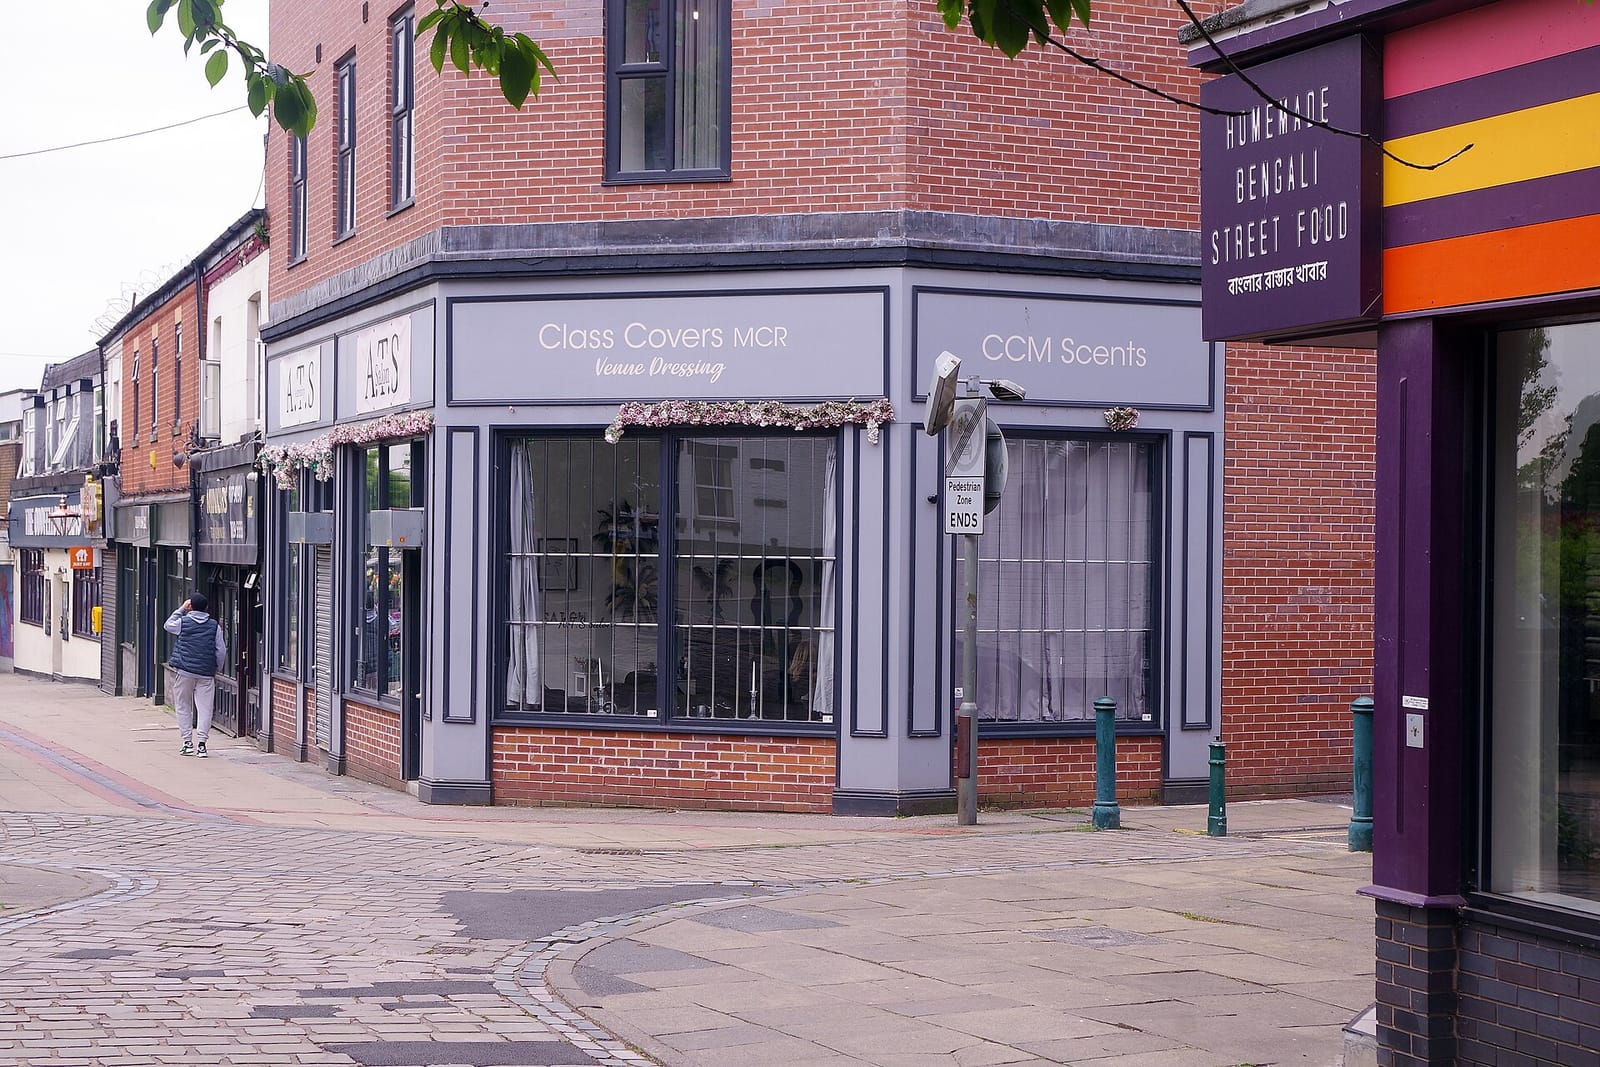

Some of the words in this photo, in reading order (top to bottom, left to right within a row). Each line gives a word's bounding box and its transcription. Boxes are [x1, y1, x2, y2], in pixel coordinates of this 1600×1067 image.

[1226, 86, 1330, 150] HOMEMADE
[1236, 148, 1320, 204] BENGALI
[1212, 215, 1281, 265] STREET
[1297, 200, 1348, 248] FOOD
[1227, 273, 1263, 296] বাংলার
[1263, 267, 1295, 292] রাস্তার
[1295, 260, 1328, 286] খাবার
[538, 323, 615, 350] Class
[624, 322, 723, 349] Covers
[733, 326, 788, 348] MCR
[982, 334, 1052, 363] CCM
[1061, 337, 1147, 367] Scents
[595, 356, 645, 377] Venue
[649, 356, 727, 384] Dressing
[948, 481, 981, 492] Pedestrian
[956, 494, 972, 505] Zone
[950, 512, 978, 528] ENDS
